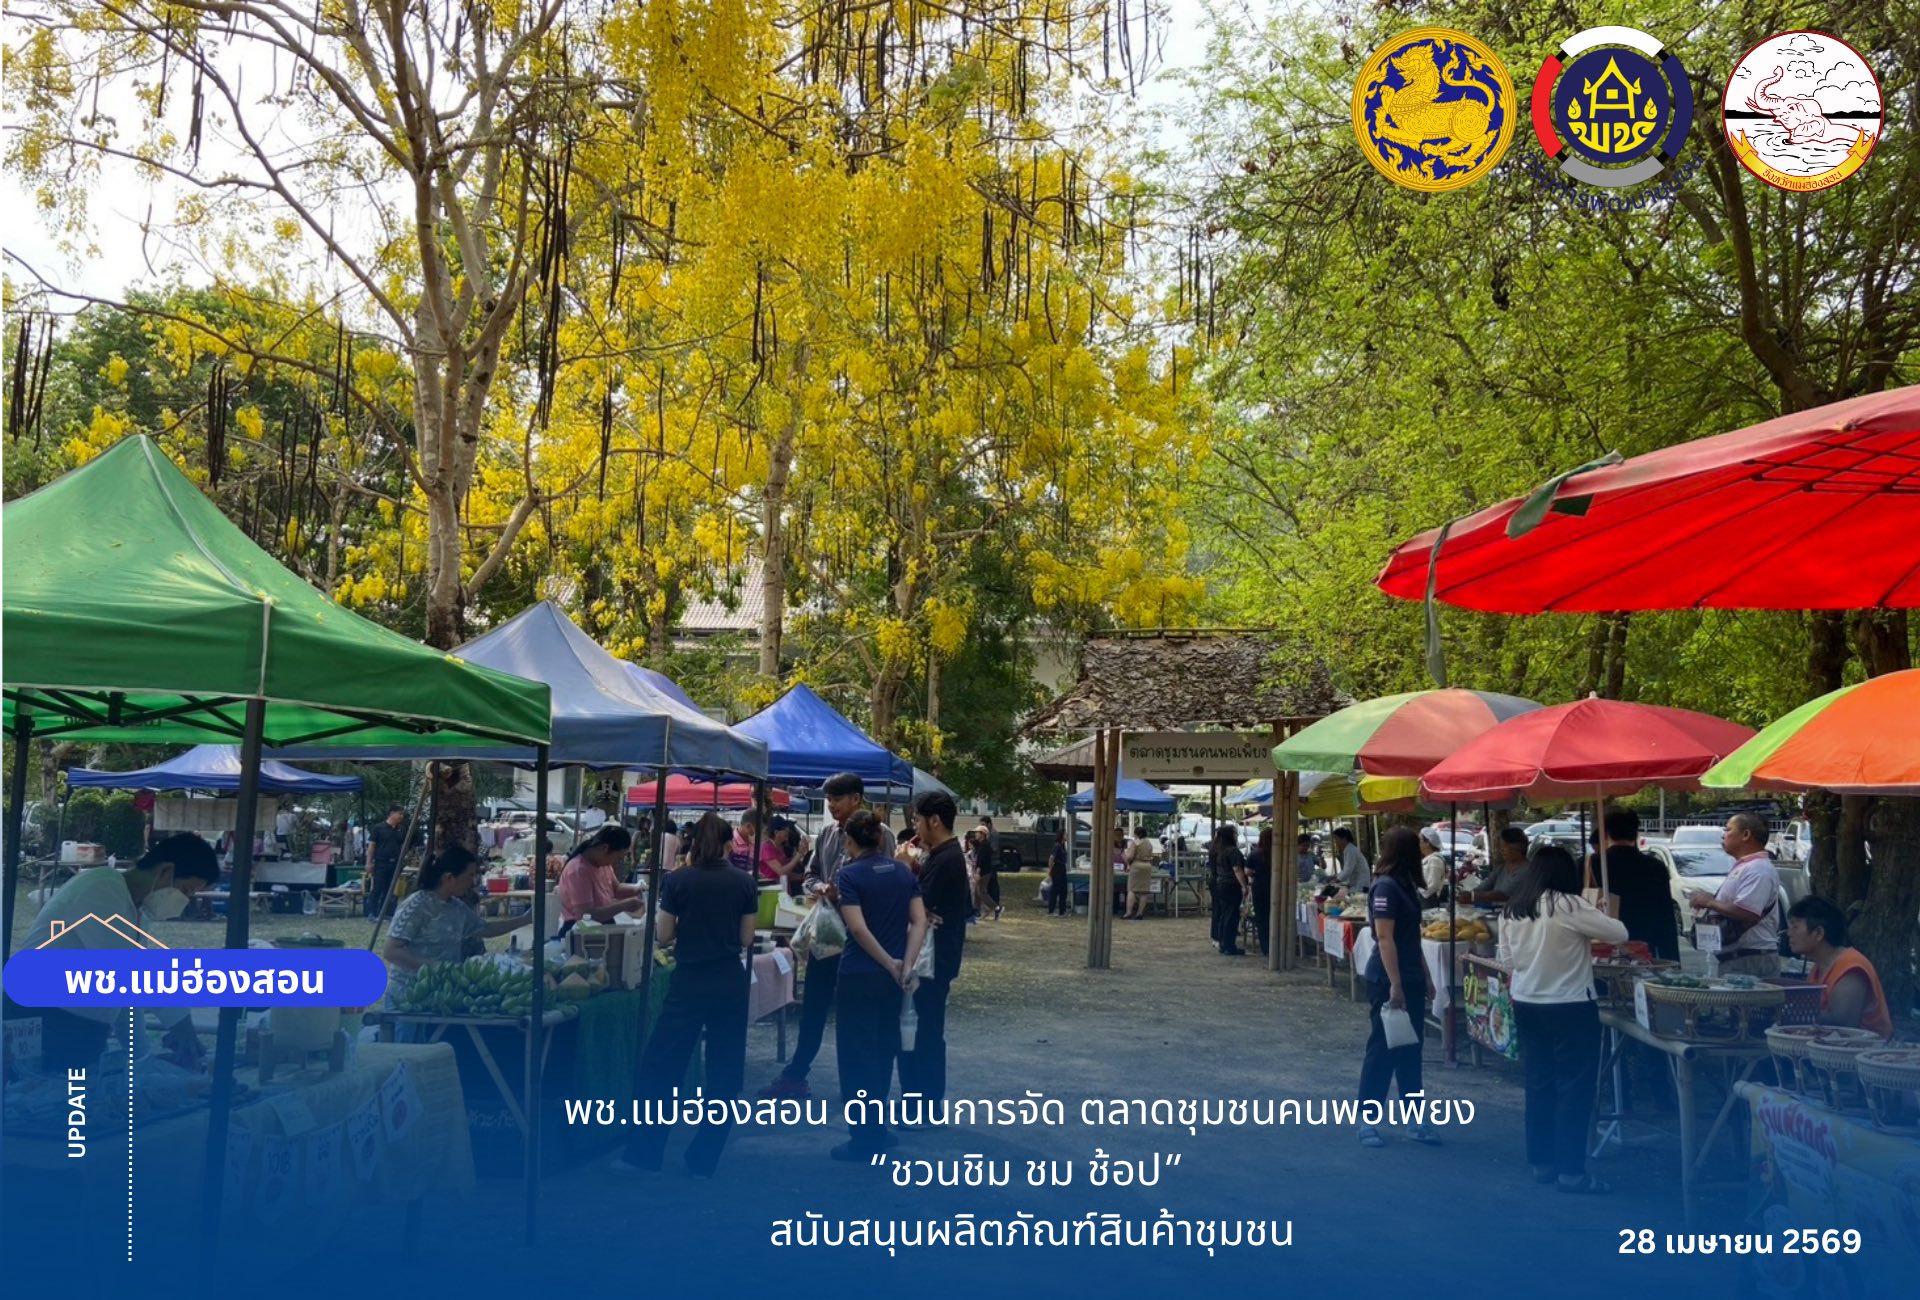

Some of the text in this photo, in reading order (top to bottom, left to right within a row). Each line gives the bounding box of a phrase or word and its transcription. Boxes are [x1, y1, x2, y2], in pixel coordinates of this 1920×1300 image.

[1129, 743, 1268, 764] ตลาดชุมชนคนพอเพียง
